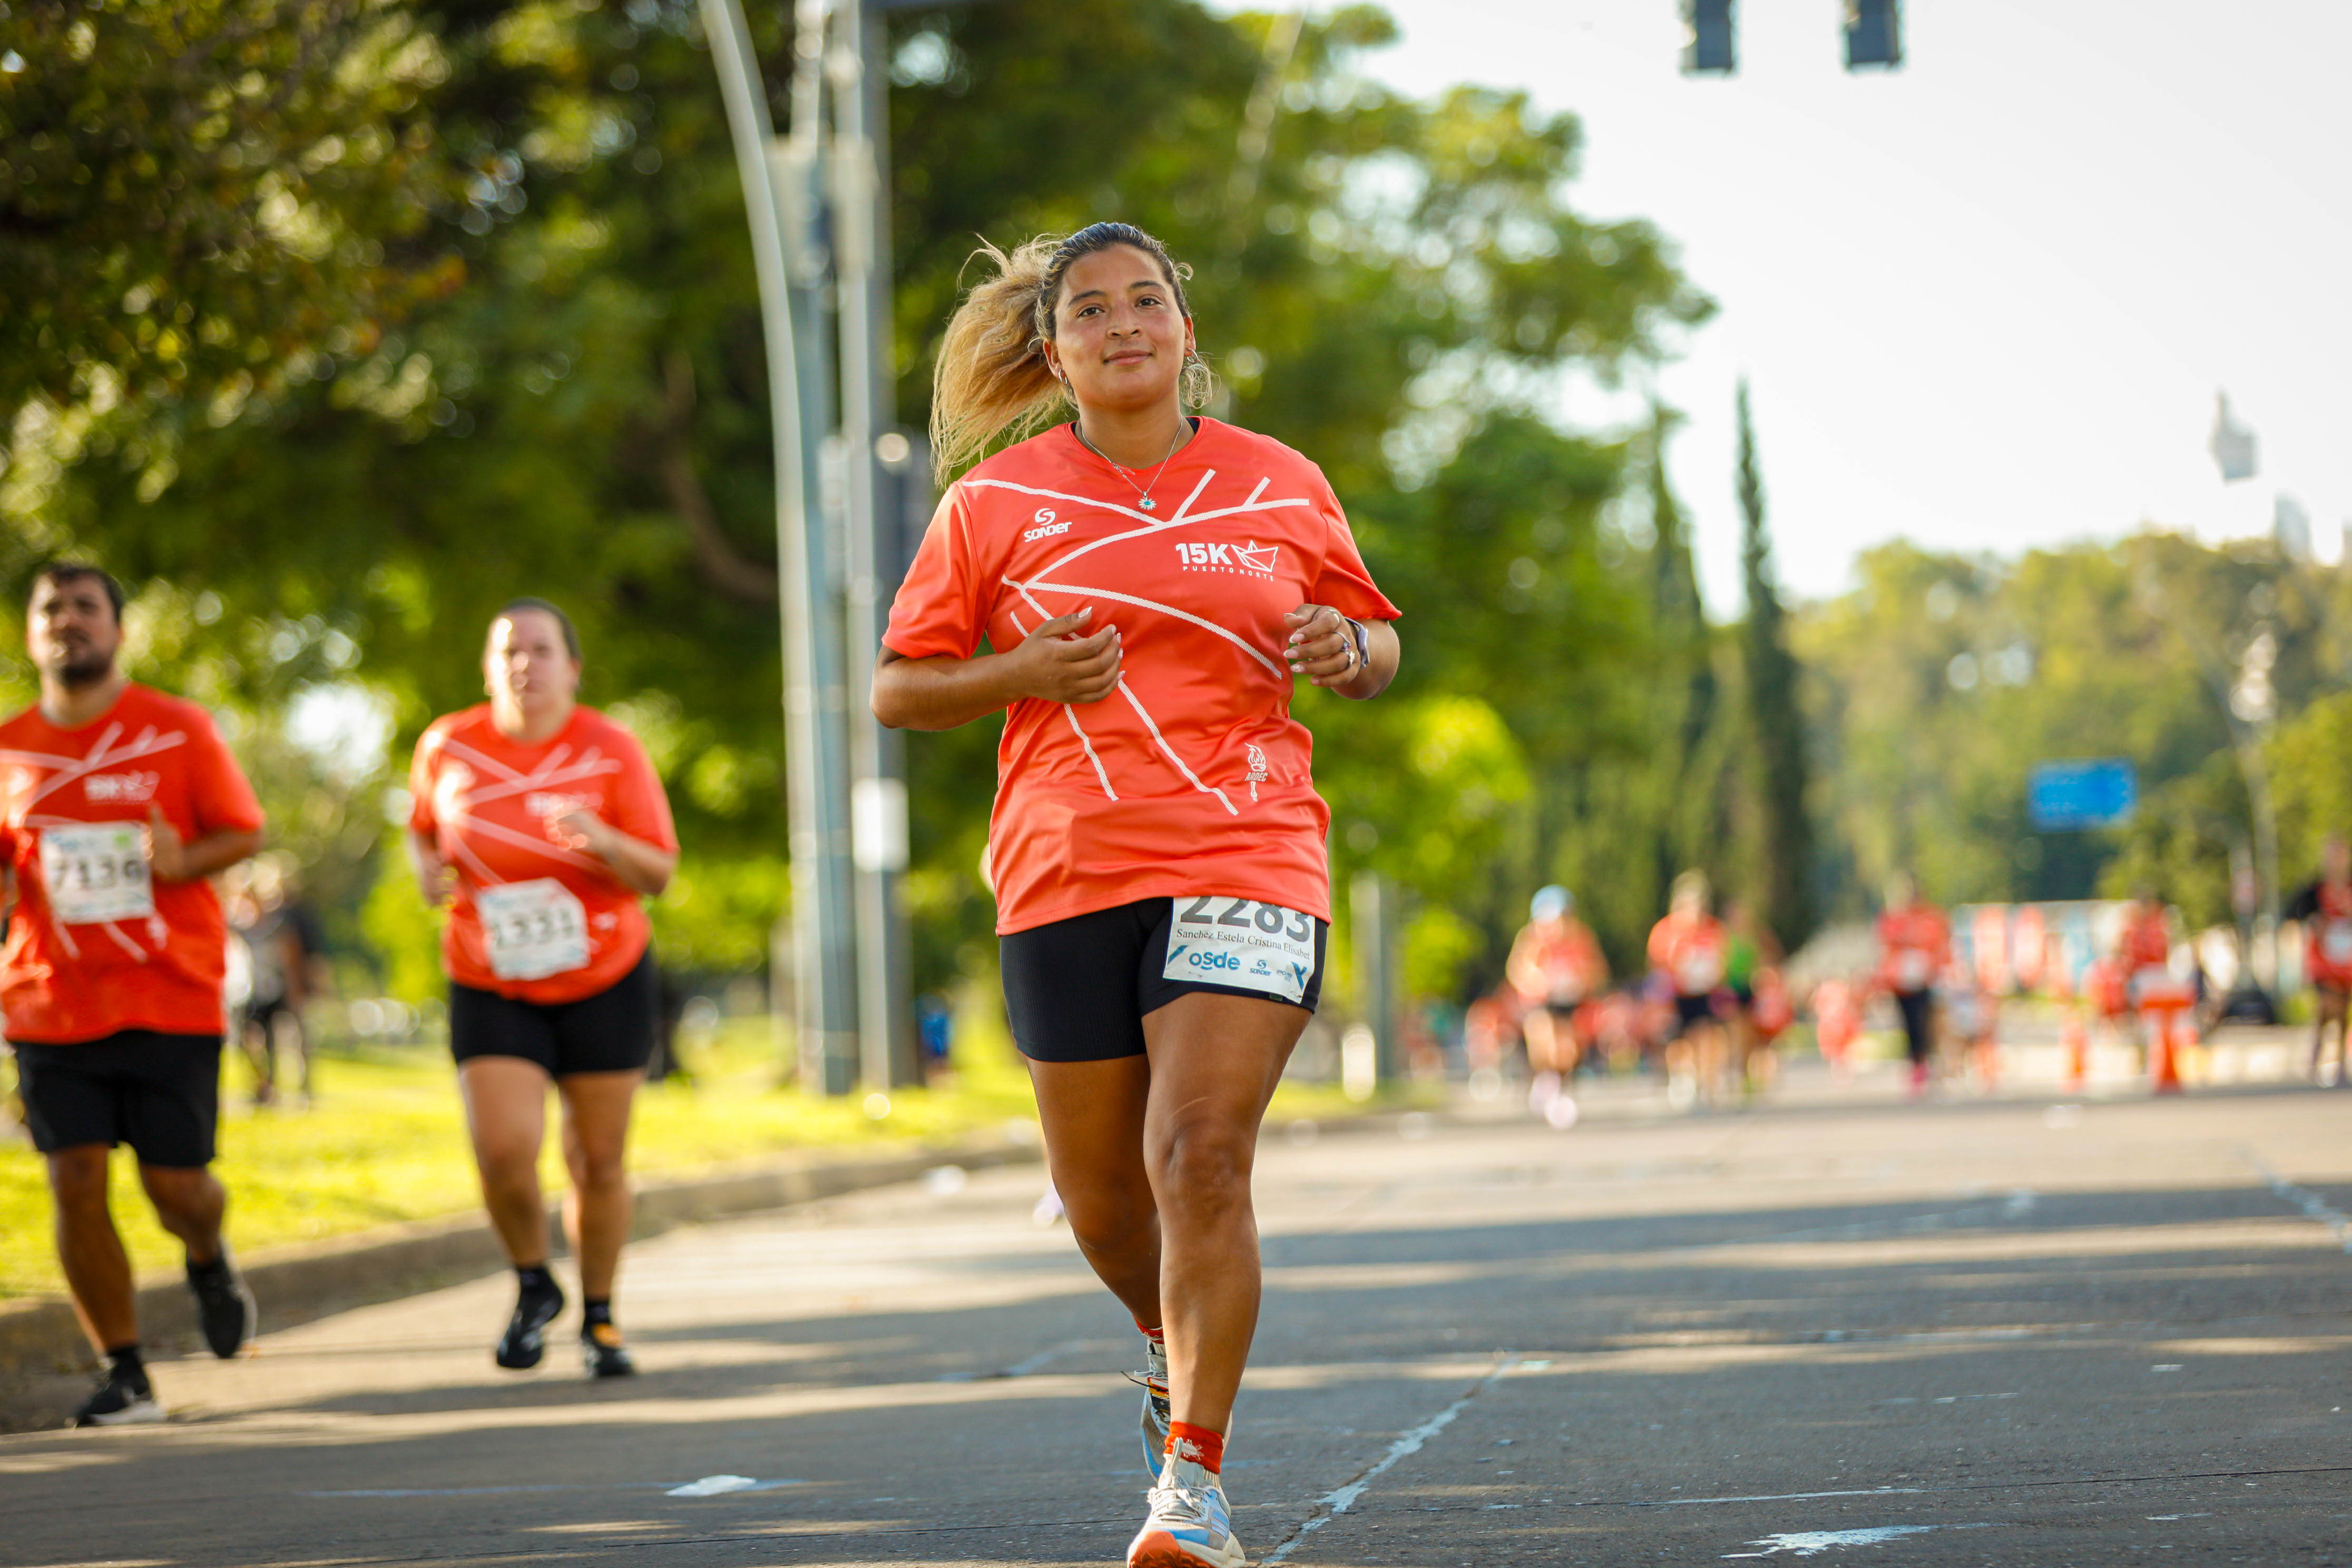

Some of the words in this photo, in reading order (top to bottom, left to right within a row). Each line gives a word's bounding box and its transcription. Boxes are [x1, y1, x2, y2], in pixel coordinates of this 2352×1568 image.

[1175, 543, 1232, 565] 15K
[1239, 569, 1273, 582] NORTE
[1244, 772, 1268, 782] ARDEC
[1177, 928, 1213, 939] Sanchez
[1217, 931, 1244, 943] Estela
[1248, 935, 1281, 949] Cristina
[1284, 943, 1310, 960] Elisabet
[1189, 952, 1240, 970] osde
